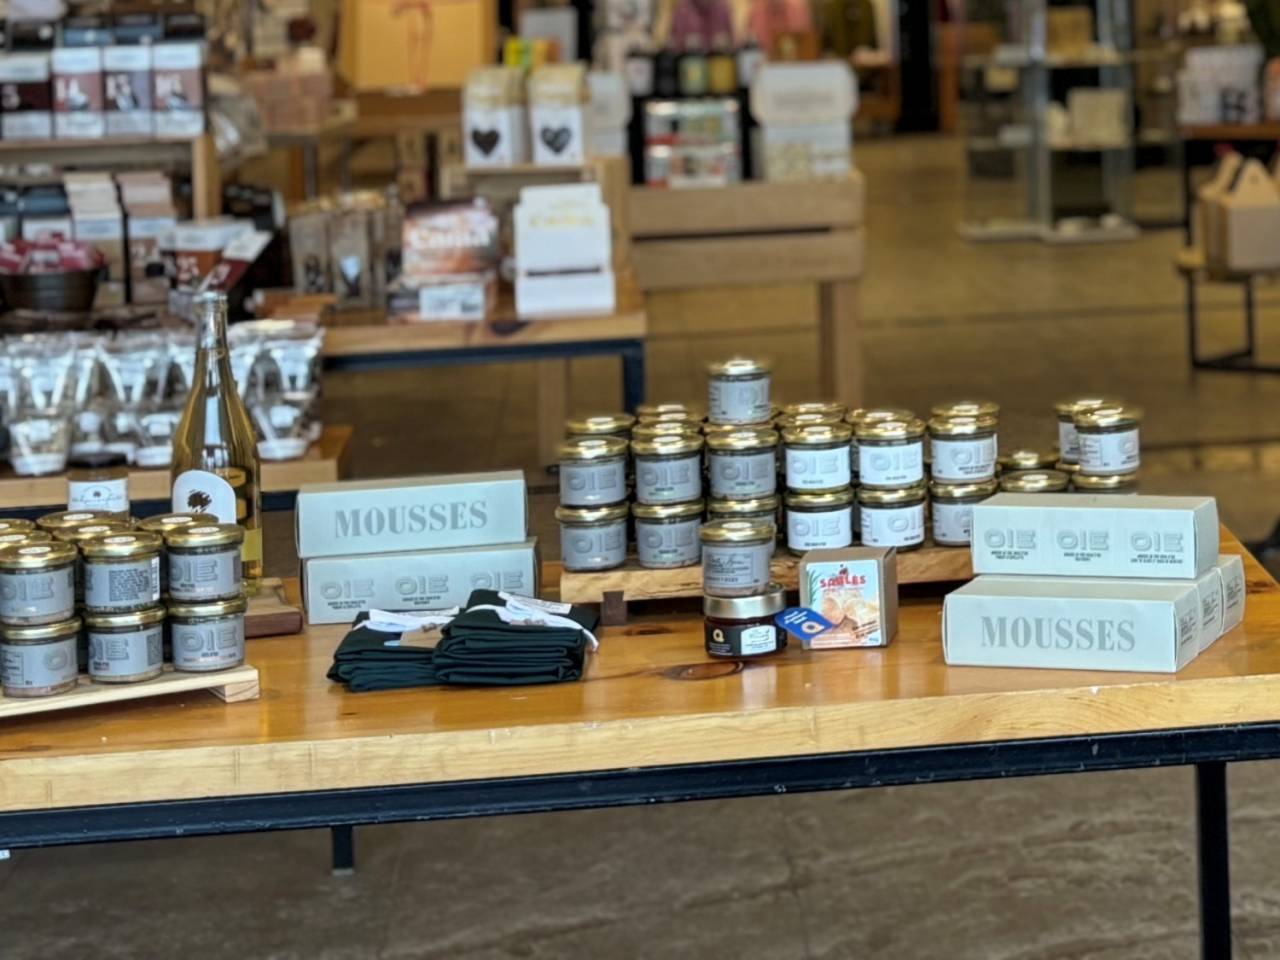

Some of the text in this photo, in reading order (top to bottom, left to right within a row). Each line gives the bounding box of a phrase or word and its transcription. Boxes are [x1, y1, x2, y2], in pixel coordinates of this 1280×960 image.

[333, 499, 489, 539] MOUSSES
[983, 528, 1037, 550] OIE
[1055, 530, 1110, 552] OIE
[1129, 531, 1184, 553] OIE
[319, 577, 375, 600] OIE
[394, 573, 450, 596] OIE
[979, 615, 1137, 653] MOUSSES
